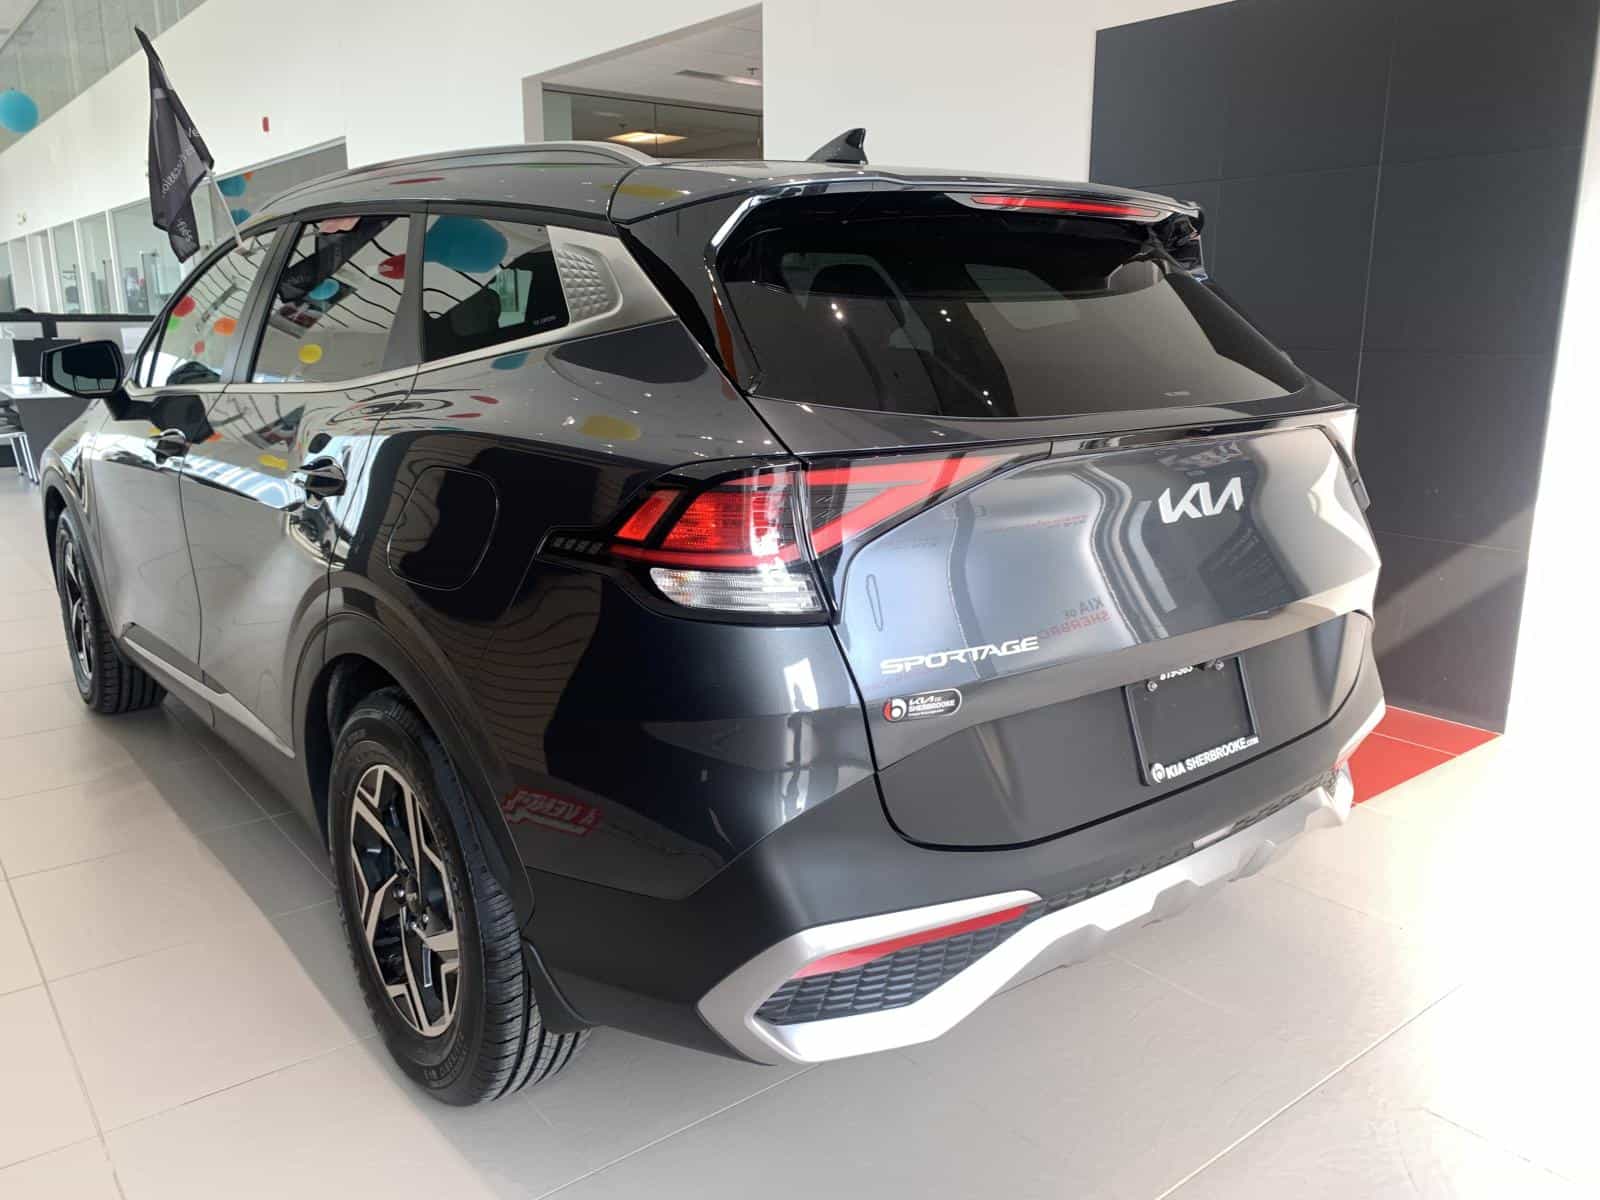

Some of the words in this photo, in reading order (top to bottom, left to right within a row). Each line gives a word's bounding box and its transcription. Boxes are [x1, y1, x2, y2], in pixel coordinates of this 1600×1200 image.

[1158, 476, 1244, 524] KIA
[880, 636, 1040, 675] SPORTAGE
[909, 696, 935, 706] KIA
[1165, 761, 1187, 779] KIA
